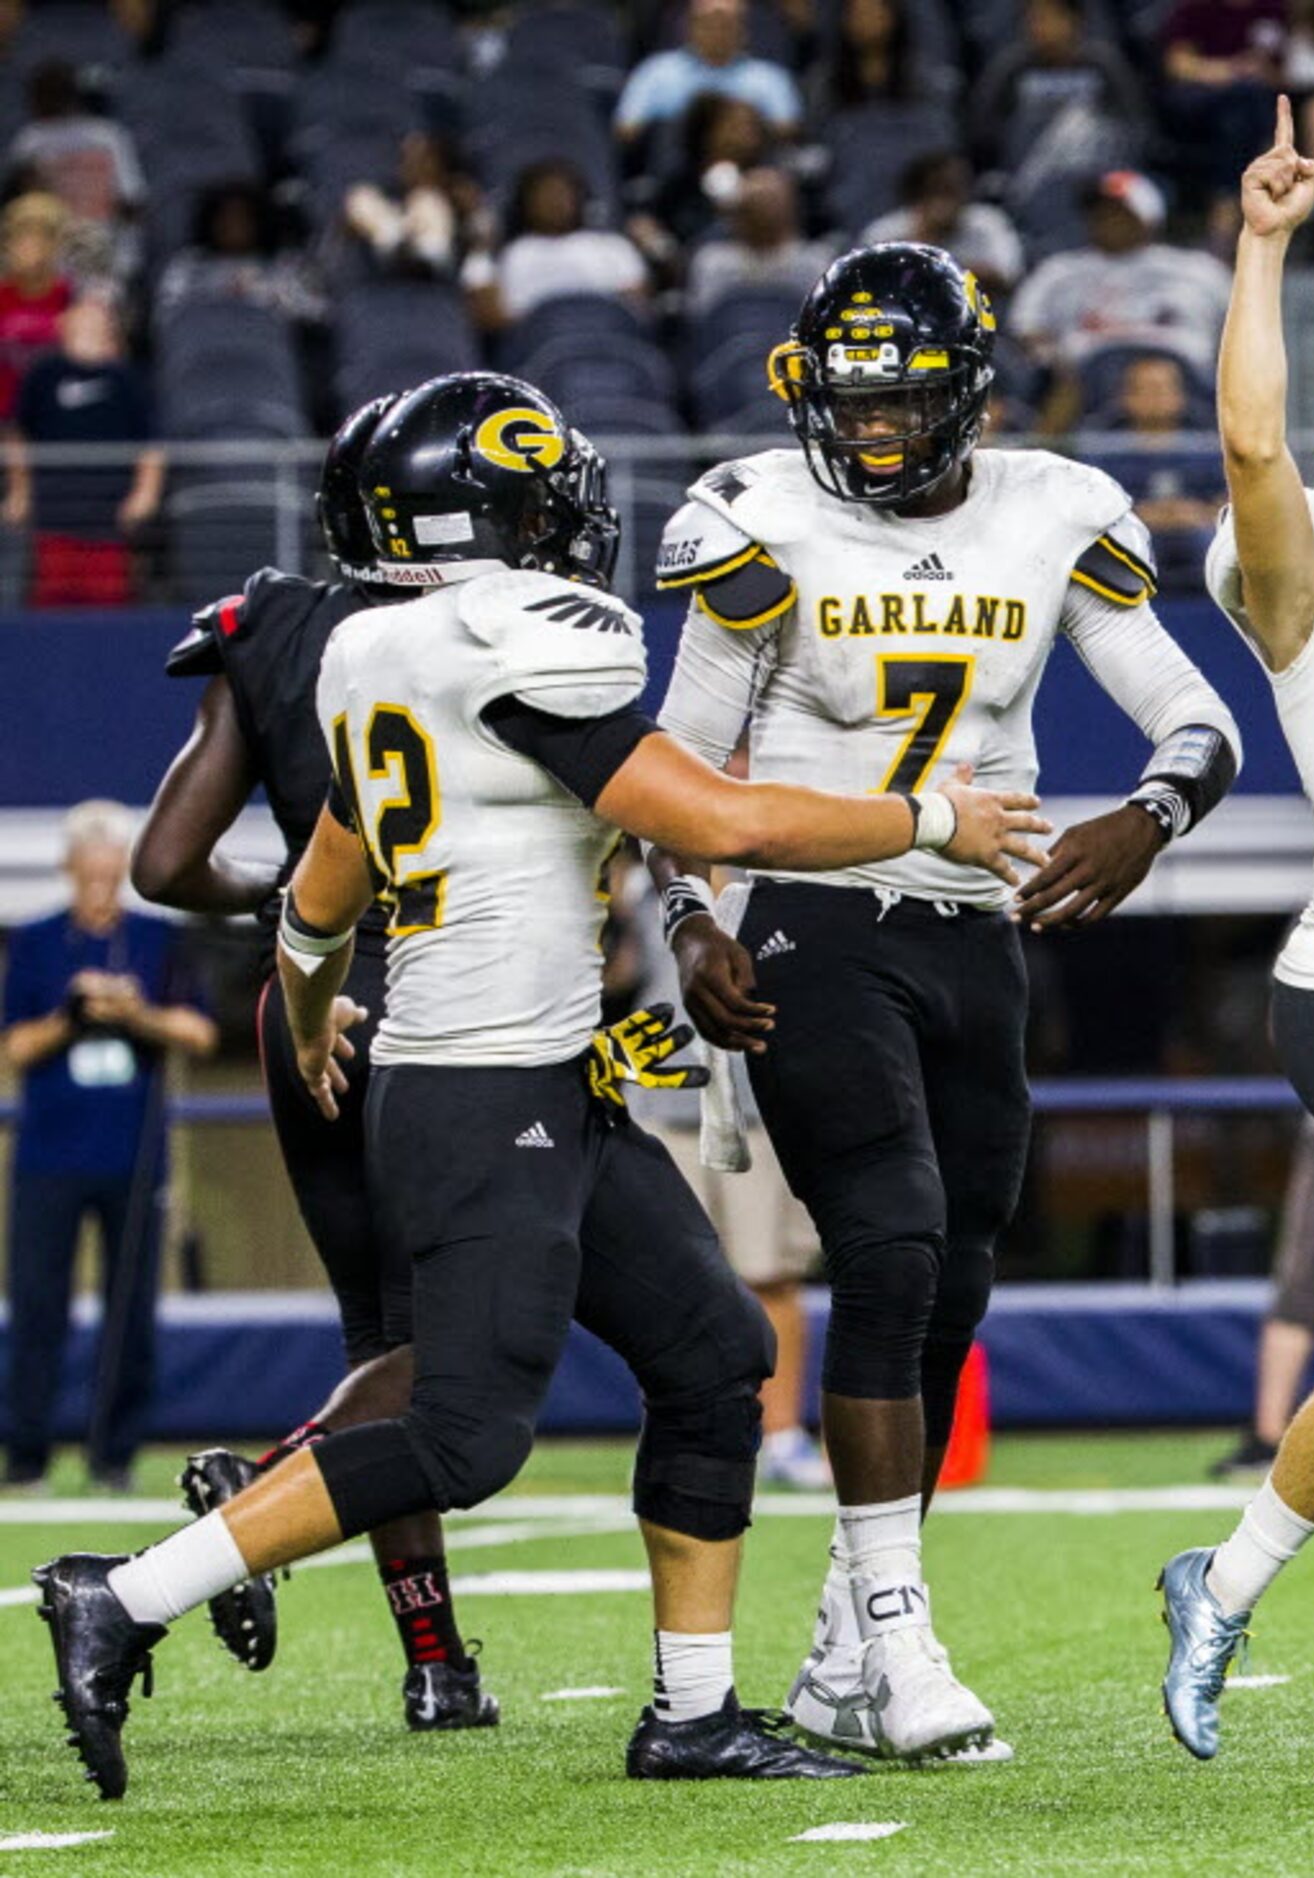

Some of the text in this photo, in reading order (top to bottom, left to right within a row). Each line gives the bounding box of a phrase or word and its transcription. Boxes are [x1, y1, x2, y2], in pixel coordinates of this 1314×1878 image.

[476, 407, 566, 473] G
[902, 568, 954, 581] adidas
[818, 593, 1027, 642] GARLAND
[866, 653, 977, 796] 7
[387, 1572, 442, 1615] H
